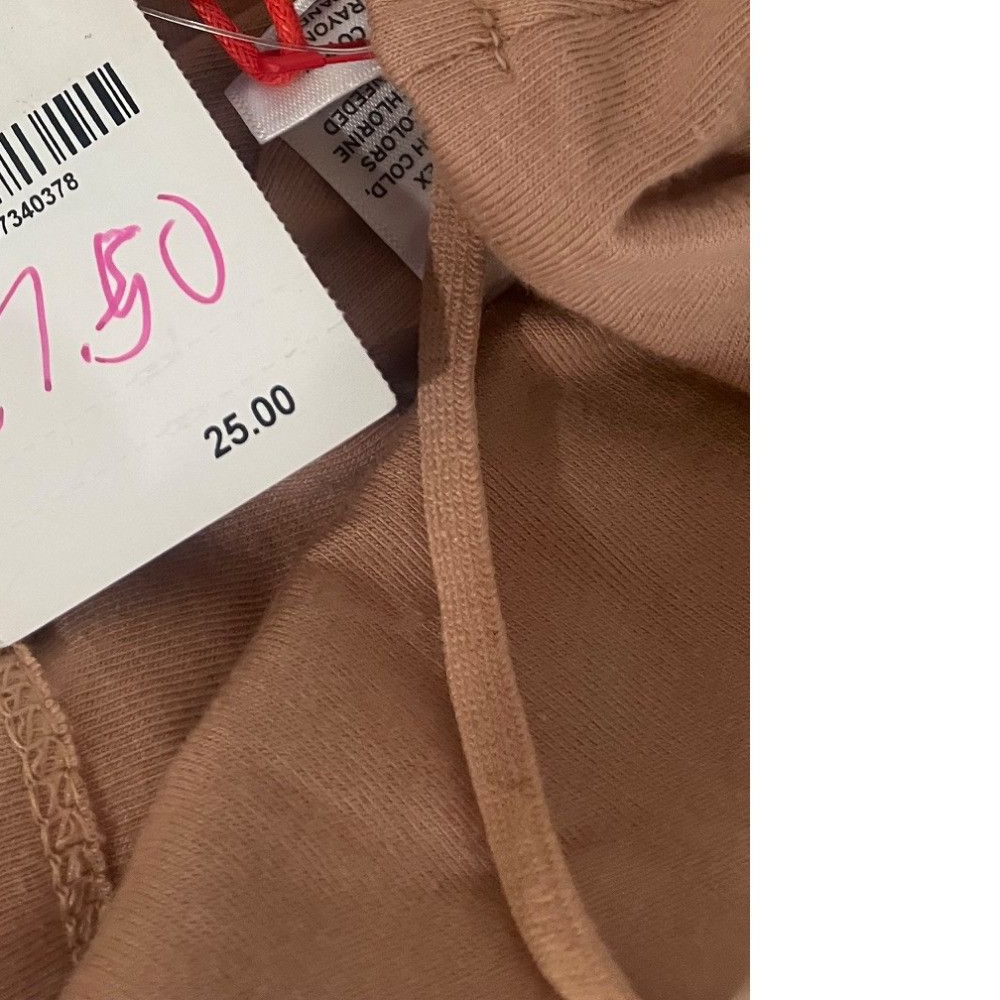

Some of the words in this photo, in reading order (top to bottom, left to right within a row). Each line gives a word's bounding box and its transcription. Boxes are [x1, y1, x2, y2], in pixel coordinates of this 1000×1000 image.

[332, 89, 405, 163] HLORINE
[364, 153, 414, 198] COLD,
[203, 384, 297, 460] 25.00
